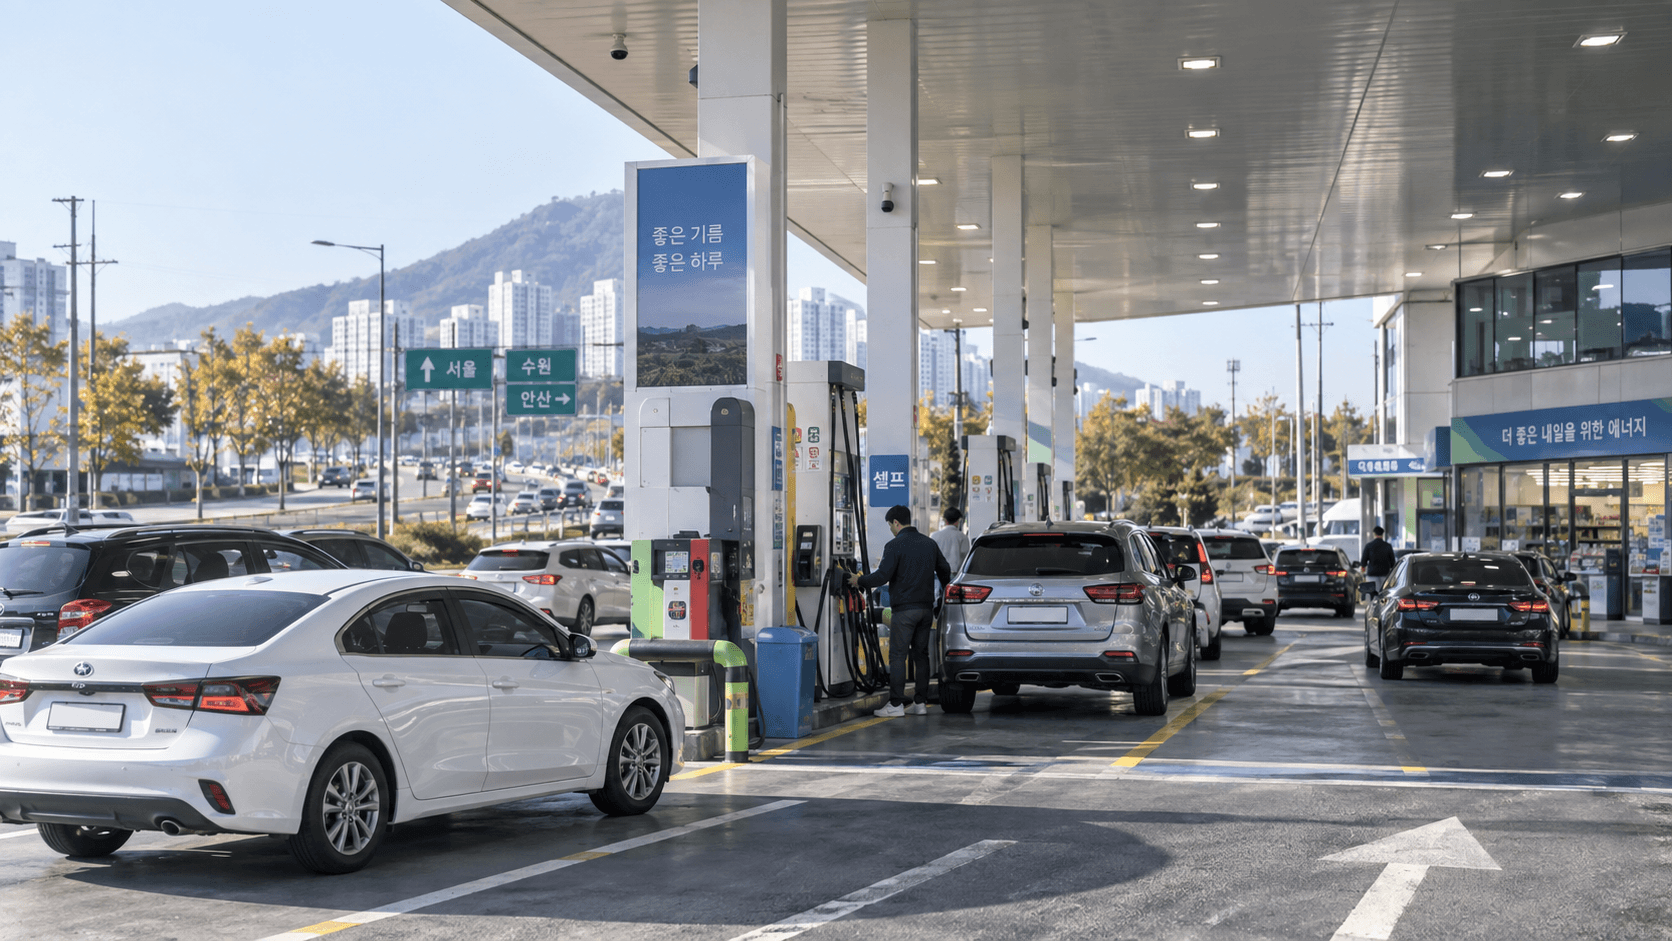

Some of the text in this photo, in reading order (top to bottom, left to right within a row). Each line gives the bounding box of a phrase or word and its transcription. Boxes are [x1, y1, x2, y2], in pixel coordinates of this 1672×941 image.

[652, 224, 724, 246] 좋은 기름
[652, 252, 724, 273] 좋은 하루
[446, 360, 477, 378] 서울
[521, 357, 551, 376] 수원
[521, 390, 551, 408] 안산
[1502, 427, 1512, 446] 더
[1516, 425, 1538, 446] 좋은
[1541, 422, 1576, 443] 내일을
[1580, 419, 1604, 441] 위한
[873, 470, 905, 489] 셀프
